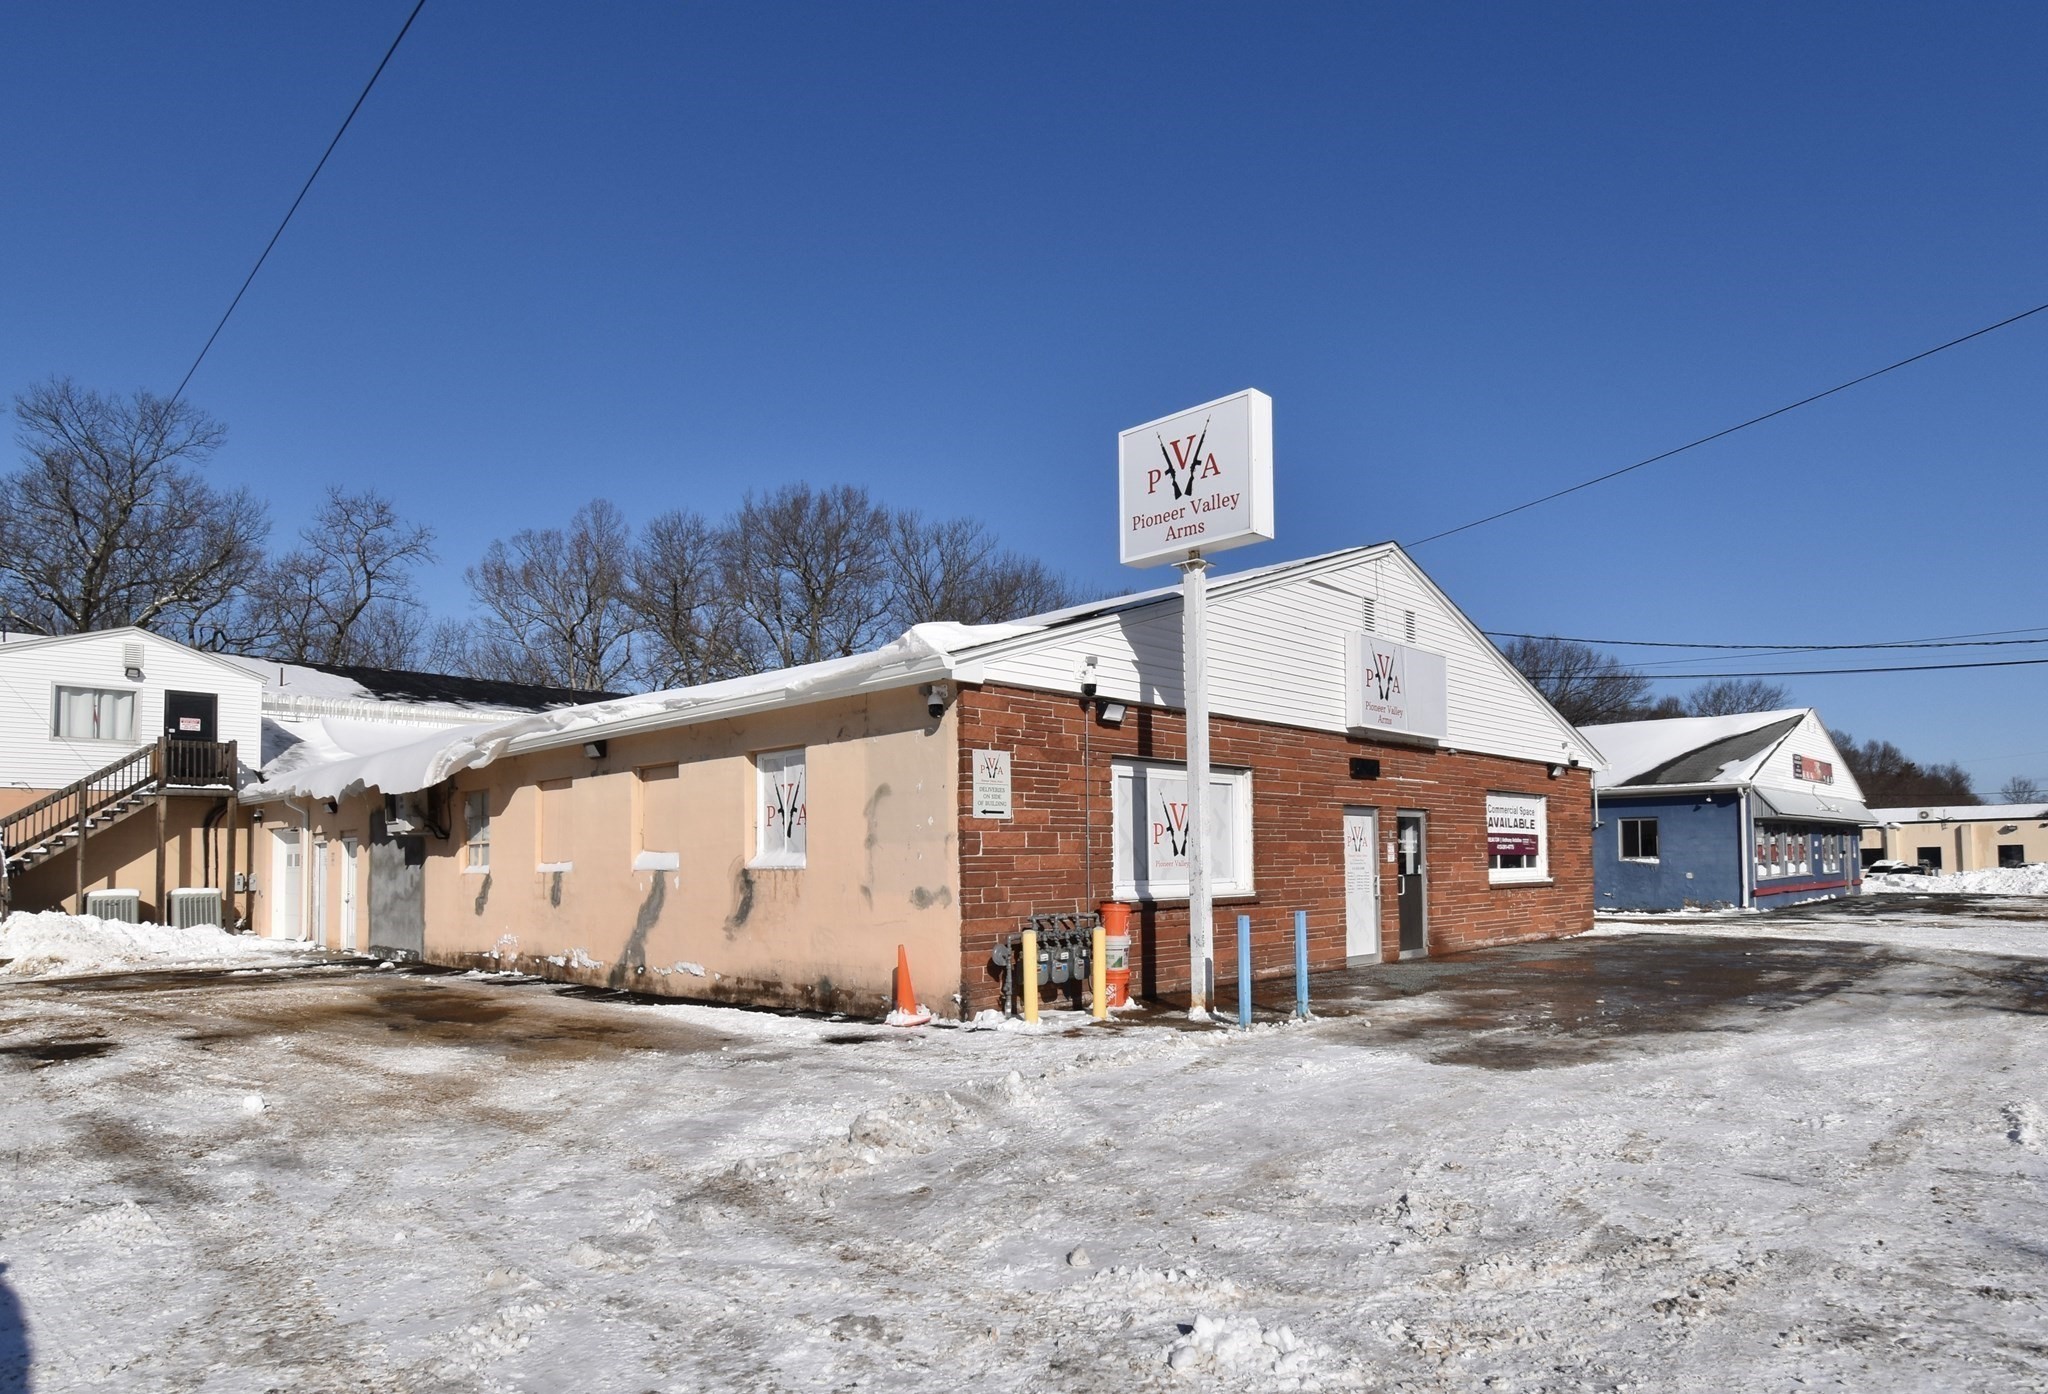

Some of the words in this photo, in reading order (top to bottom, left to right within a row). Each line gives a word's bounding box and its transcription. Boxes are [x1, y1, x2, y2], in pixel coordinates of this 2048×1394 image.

[1132, 506, 1186, 531] Pioneer
[1190, 492, 1241, 515] Valley
[1165, 521, 1205, 541] Arms
[1365, 701, 1386, 713] Pioneer
[1387, 705, 1403, 718] Valley
[1377, 714, 1392, 725] Arms
[1488, 804, 1518, 815] Commercial
[1519, 806, 1535, 817] Space
[1488, 817, 1535, 829] AVAILABLE
[1155, 860, 1174, 868] Pioneer
